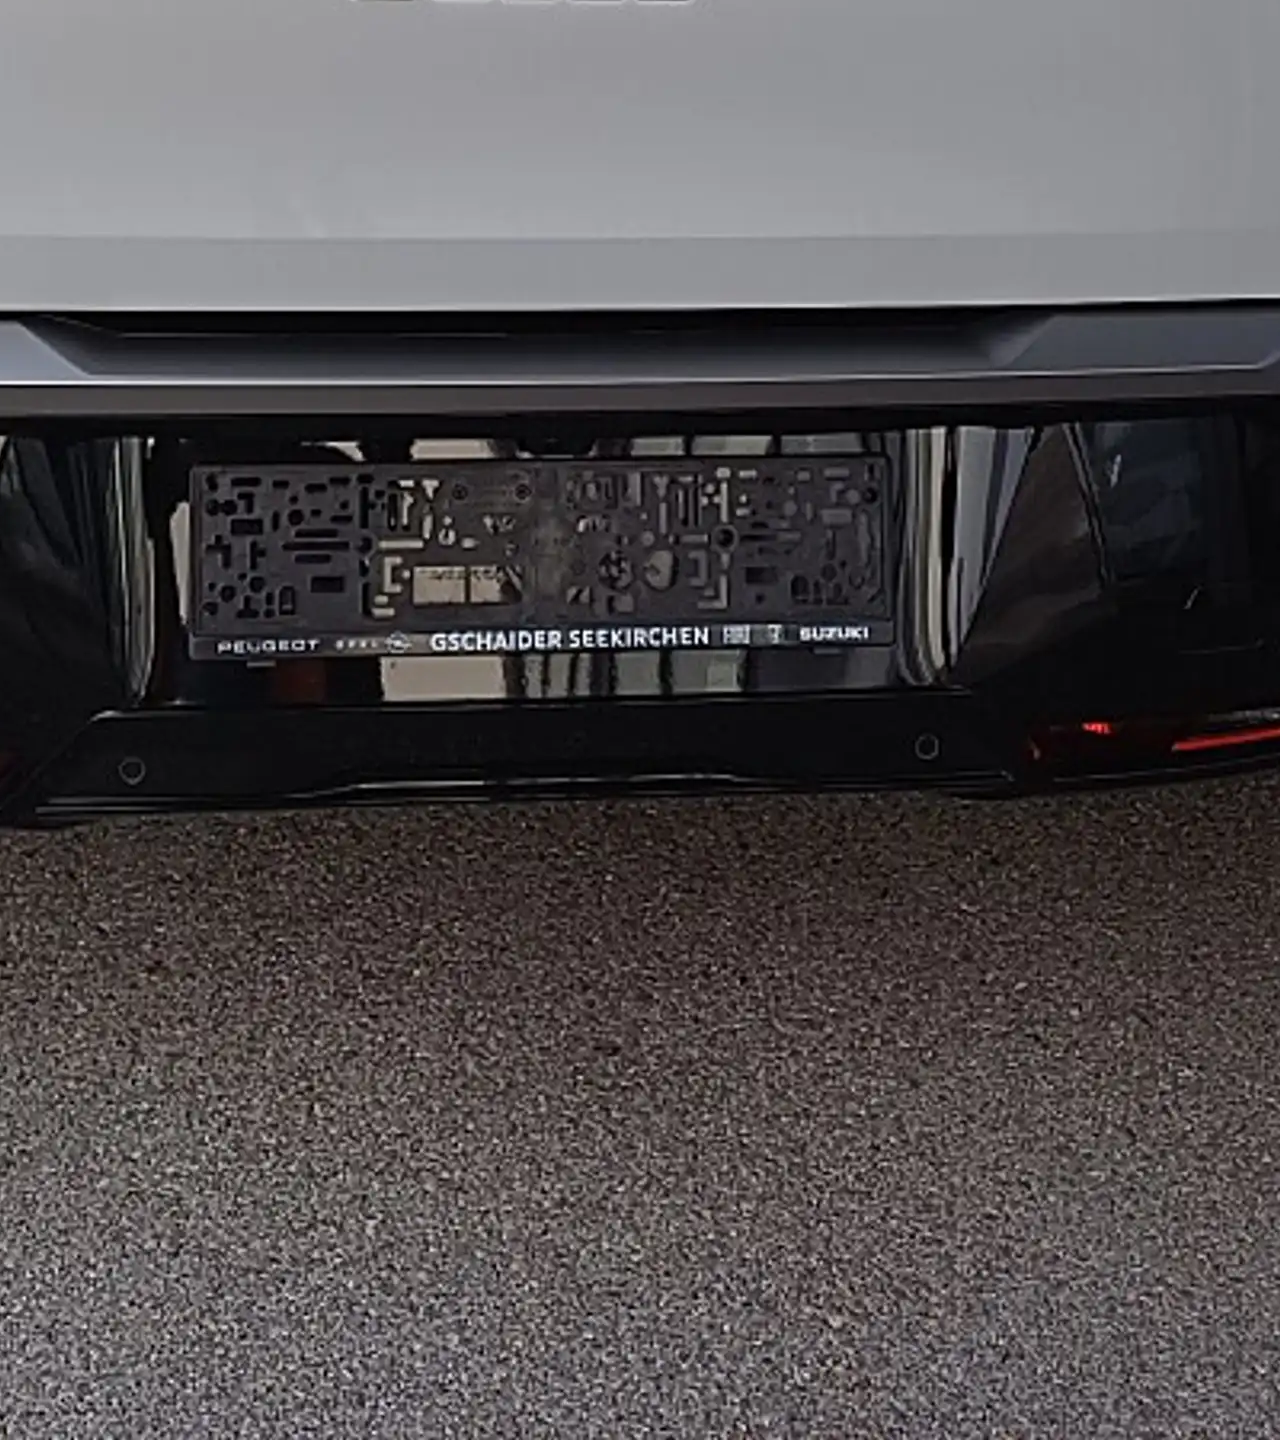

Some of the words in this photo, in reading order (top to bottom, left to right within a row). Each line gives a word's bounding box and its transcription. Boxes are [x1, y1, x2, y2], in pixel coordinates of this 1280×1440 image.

[217, 638, 320, 655] PEUGEOT
[430, 629, 563, 651] GSCHAIDER
[569, 625, 710, 649] SEEKIRCHEN
[800, 626, 871, 641] SUZUKI
